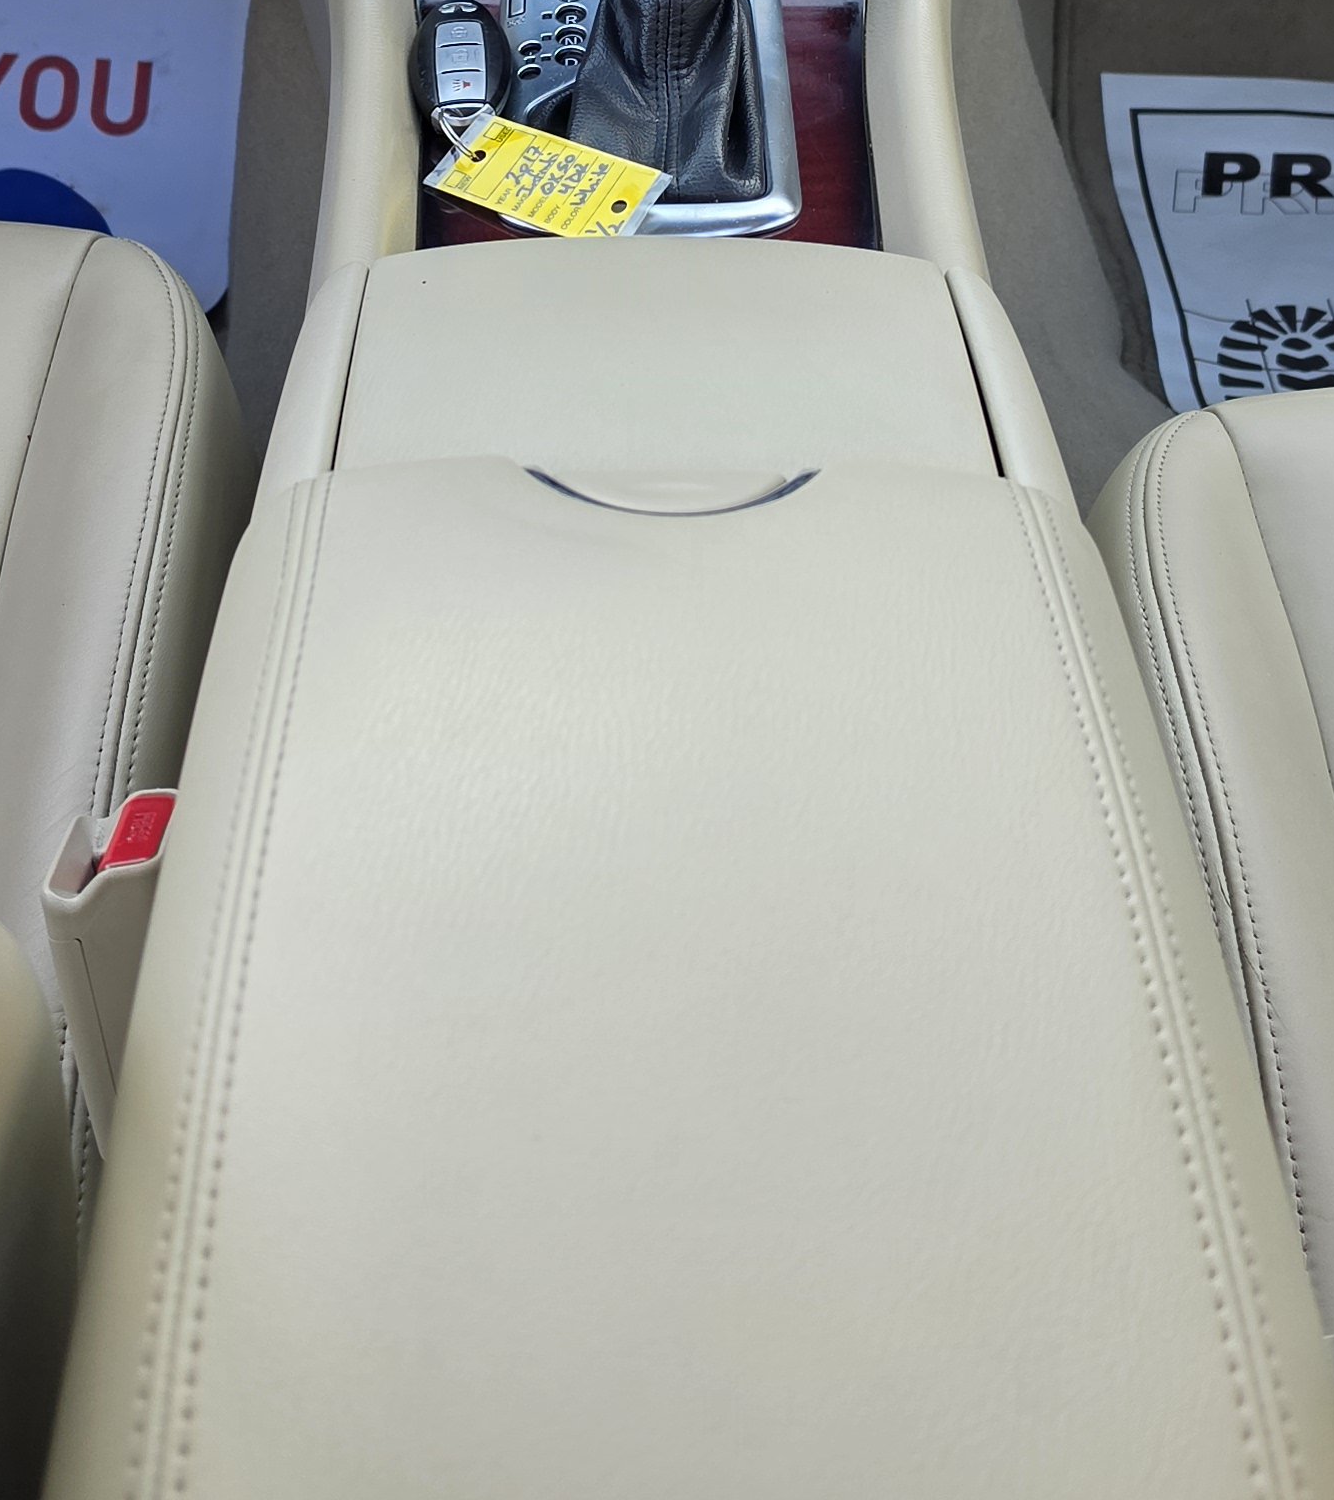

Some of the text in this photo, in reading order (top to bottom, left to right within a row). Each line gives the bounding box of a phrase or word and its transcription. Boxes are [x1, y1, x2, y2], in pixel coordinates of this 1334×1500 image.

[565, 15, 578, 24] R
[565, 36, 578, 45] N
[565, 58, 578, 66] D
[495, 188, 514, 206] YEAR
[543, 205, 561, 225] BODY
[560, 206, 582, 231] COLOR
